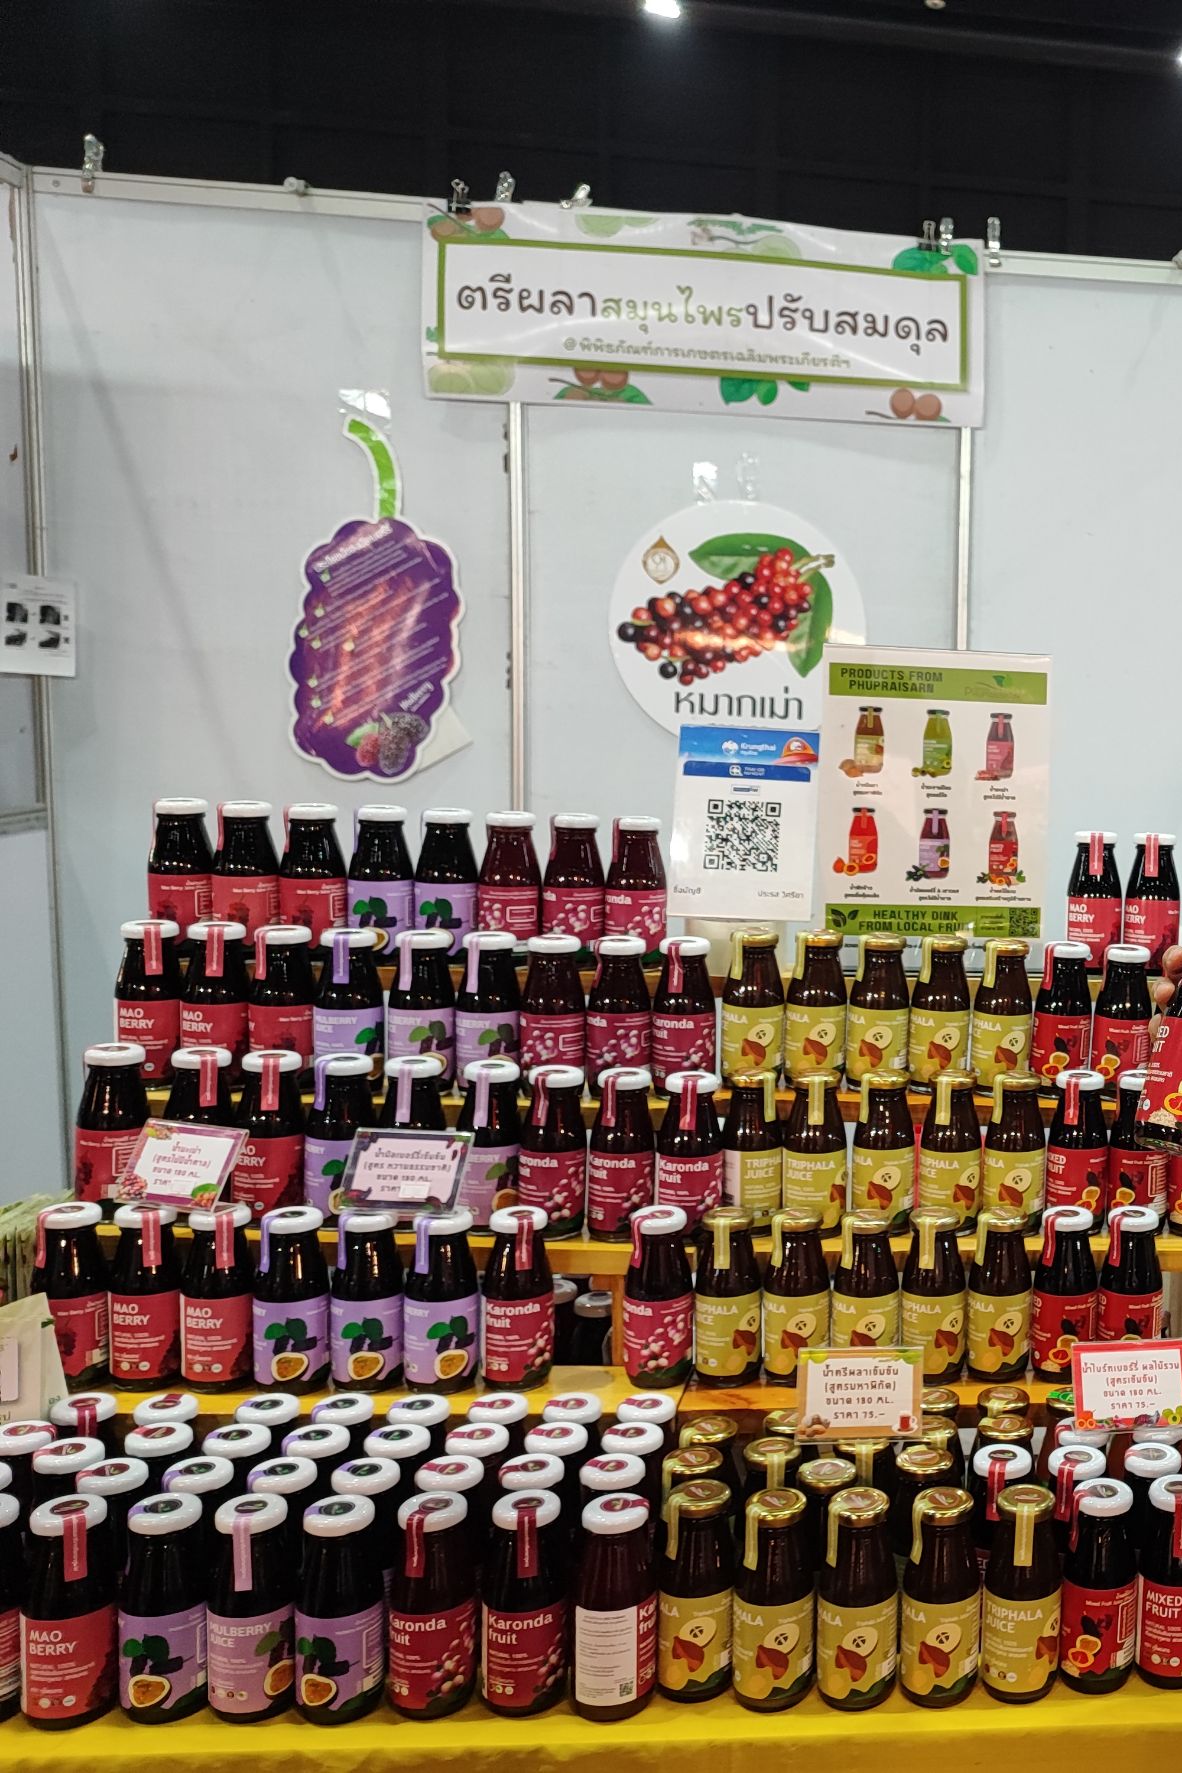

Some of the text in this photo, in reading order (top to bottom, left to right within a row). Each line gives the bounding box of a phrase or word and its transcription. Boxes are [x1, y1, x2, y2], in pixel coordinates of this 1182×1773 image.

[456, 273, 949, 355] ตรีผลาสมุนไพรปรับสมดุล
[840, 667, 943, 682] PRODUCTS FROM
[673, 685, 804, 721] หมากเม่า
[1070, 904, 1087, 913] MAO
[873, 910, 958, 921] HEALTHY DINK
[1069, 914, 1094, 924] BERRY
[859, 922, 892, 932] FROM
[897, 922, 932, 932] LOCAL
[120, 1008, 144, 1018] MAO
[120, 1019, 155, 1030] BERRY
[660, 1159, 709, 1172] Karonda
[660, 1171, 682, 1184] fruit
[744, 1167, 774, 1180] JUICE
[113, 1302, 138, 1314] MAO
[186, 1306, 212, 1318] MAO
[486, 1302, 541, 1317] Karonda
[113, 1314, 150, 1326] BERRY
[186, 1317, 223, 1330] BERRY
[486, 1316, 511, 1329] fruit
[1103, 1389, 1126, 1398] ขนาด
[826, 1397, 852, 1406] ขนาด
[1111, 1402, 1133, 1410] ราคา
[834, 1411, 858, 1420] ราคา
[1146, 1590, 1182, 1607] MIXED
[986, 1601, 1043, 1619] TRIPHALA
[1145, 1601, 1182, 1619] FRUIT
[488, 1612, 553, 1631] Karonda
[29, 1630, 62, 1643] MAO
[488, 1629, 517, 1645] fruit
[29, 1641, 77, 1655] BERRY
